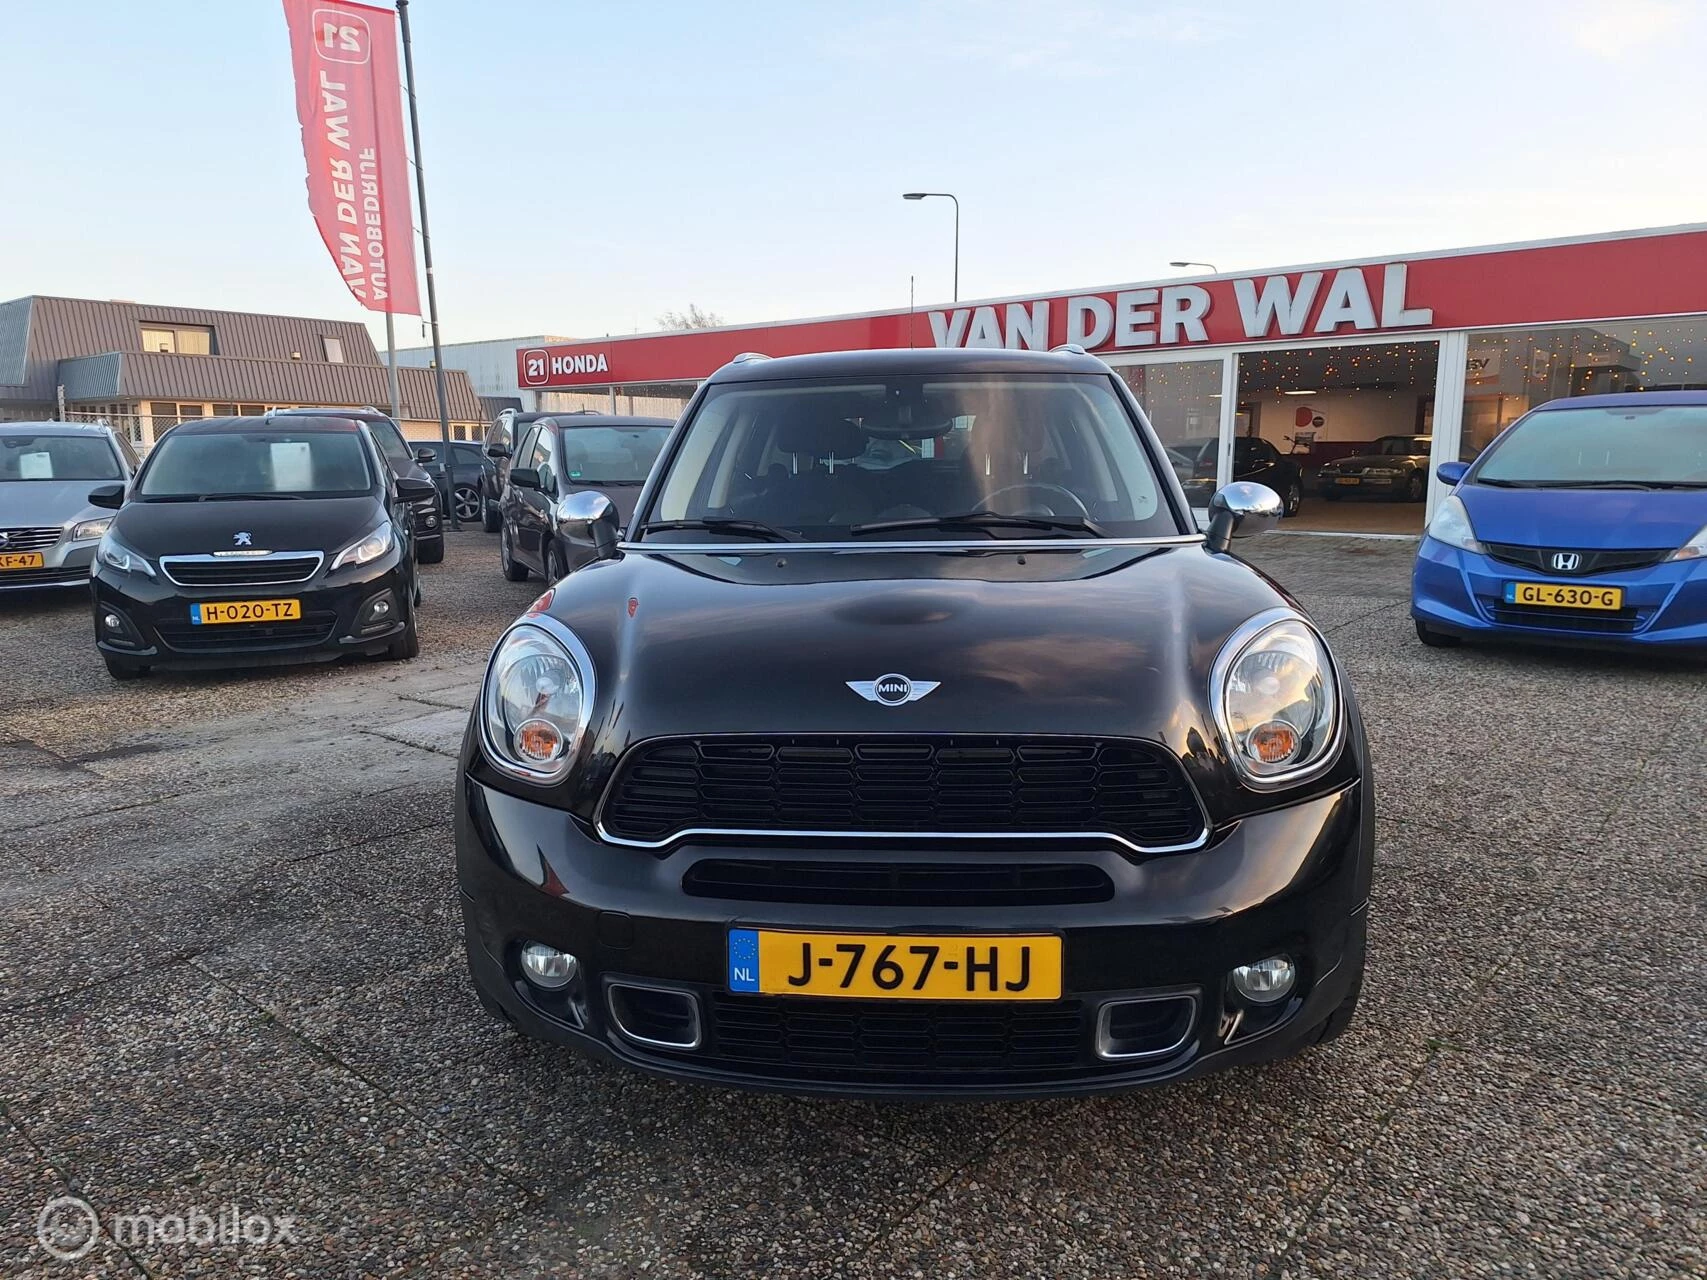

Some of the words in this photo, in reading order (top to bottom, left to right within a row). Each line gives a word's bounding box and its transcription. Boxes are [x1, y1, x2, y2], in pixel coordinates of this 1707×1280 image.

[928, 300, 1049, 350] VAN
[1067, 285, 1211, 350] DER
[1232, 263, 1434, 338] WAL
[527, 358, 545, 377] 21
[552, 353, 608, 375] HONDA
[1523, 586, 1613, 606] GL-630-G
[206, 602, 294, 621] H-020-TZ
[878, 683, 908, 693] MINI
[733, 967, 755, 981] NL
[788, 942, 1030, 992] J-767-HJ
